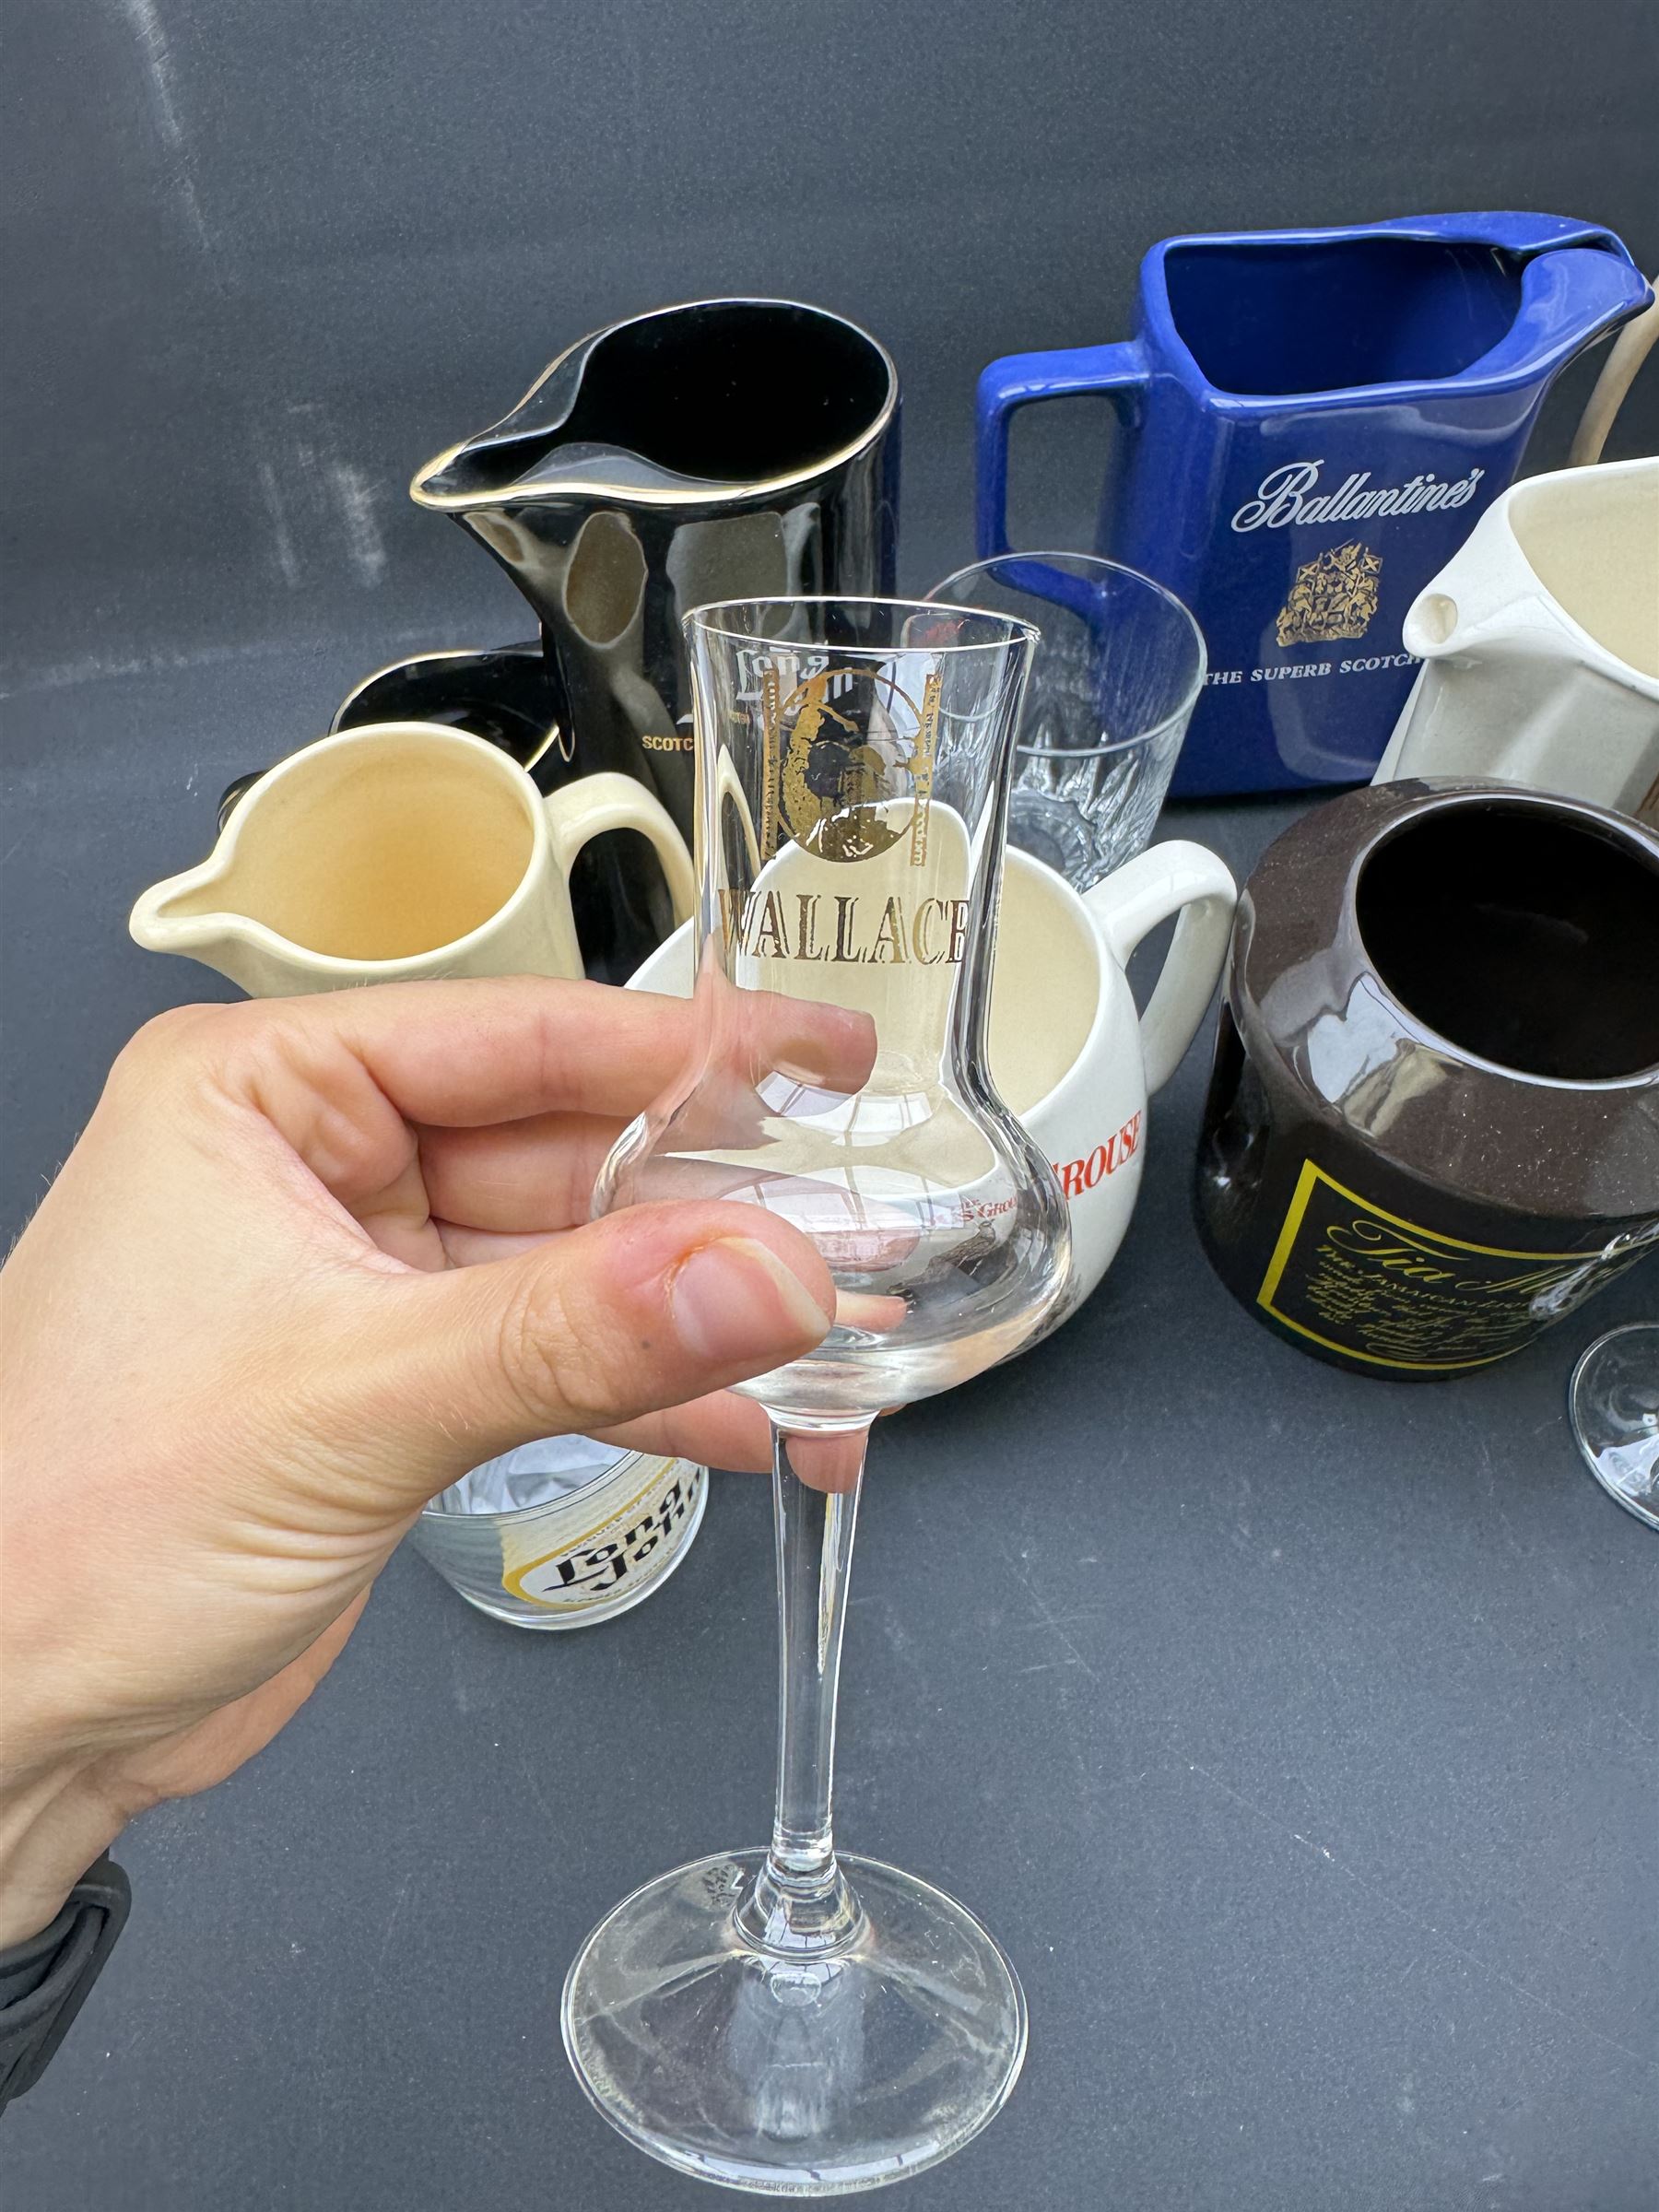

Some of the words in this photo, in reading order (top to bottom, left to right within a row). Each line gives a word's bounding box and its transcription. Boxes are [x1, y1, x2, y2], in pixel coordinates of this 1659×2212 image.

[1231, 459, 1484, 533] Ballantine's
[1204, 671, 1242, 686] THE
[1251, 663, 1331, 681] SUPERB
[642, 735, 693, 751] SCOTC
[1053, 1110, 1141, 1200] ROUSE
[1326, 1219, 1470, 1284] Tia
[542, 1480, 682, 1592] Long
